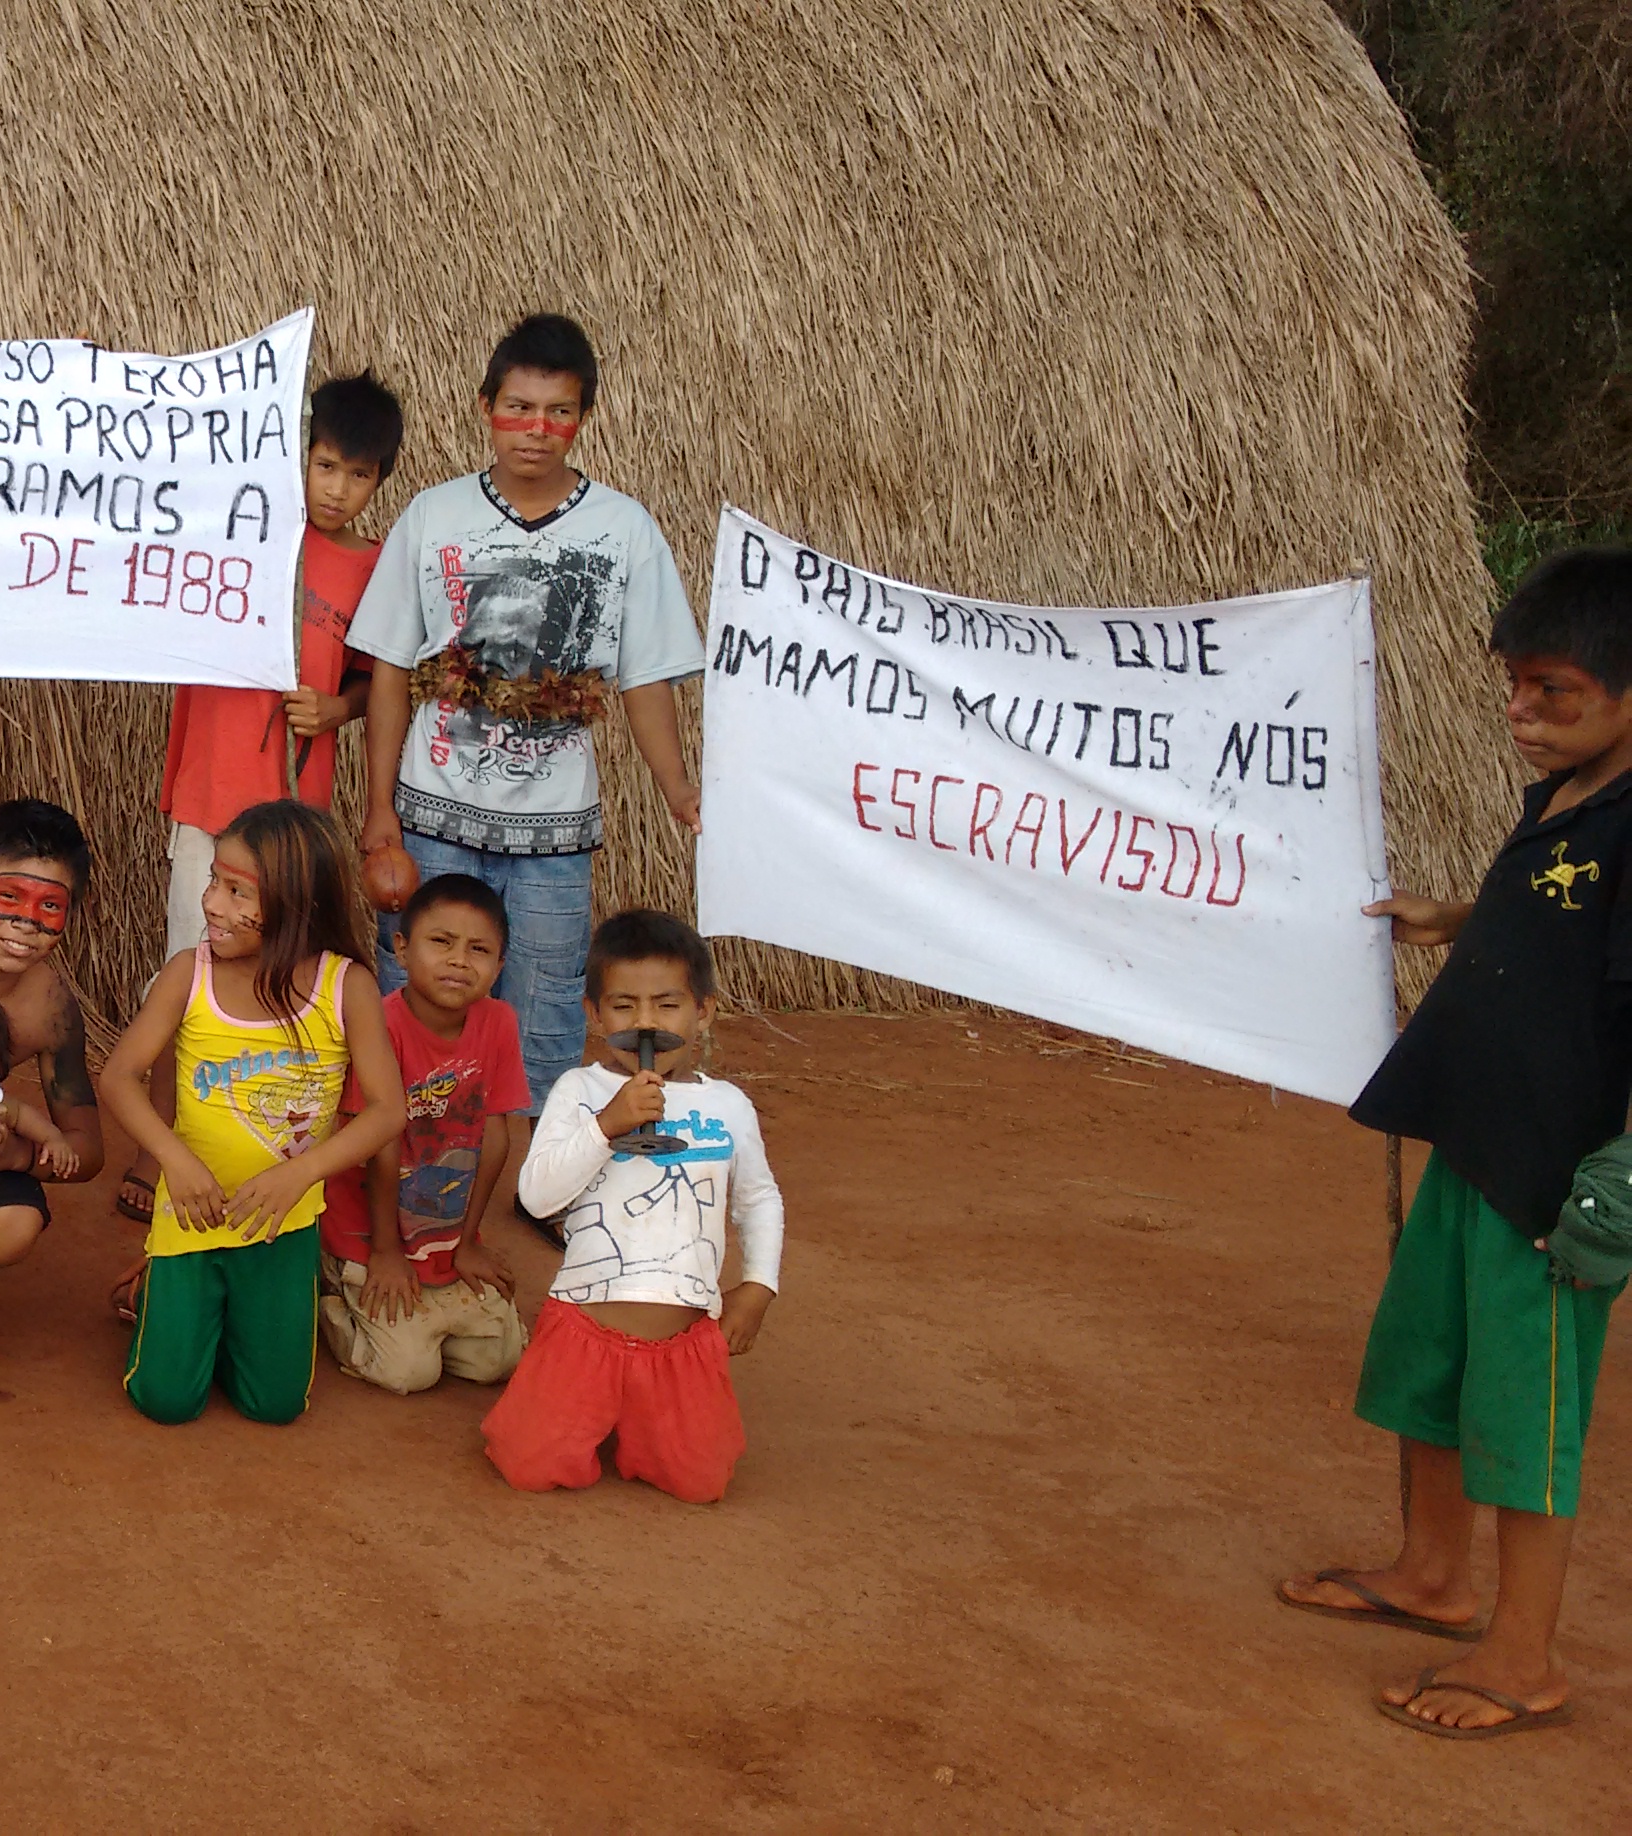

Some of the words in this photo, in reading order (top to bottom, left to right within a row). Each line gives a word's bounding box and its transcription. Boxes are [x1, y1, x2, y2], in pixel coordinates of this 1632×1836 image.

[81, 338, 279, 398] TEKOHA
[57, 397, 288, 464] PRÓPRIA
[226, 483, 271, 544] A
[8, 533, 95, 596] DE
[121, 542, 267, 627] 1988.
[741, 530, 770, 590] O
[924, 594, 1080, 660] BRASIL
[1103, 617, 1226, 675] QUE
[713, 624, 927, 721] AMAMOS
[952, 686, 1174, 771] MUITOS
[1216, 689, 1328, 790] NÓS
[414, 805, 445, 828] RAP
[459, 817, 488, 840] RAP
[504, 827, 535, 845] RAP
